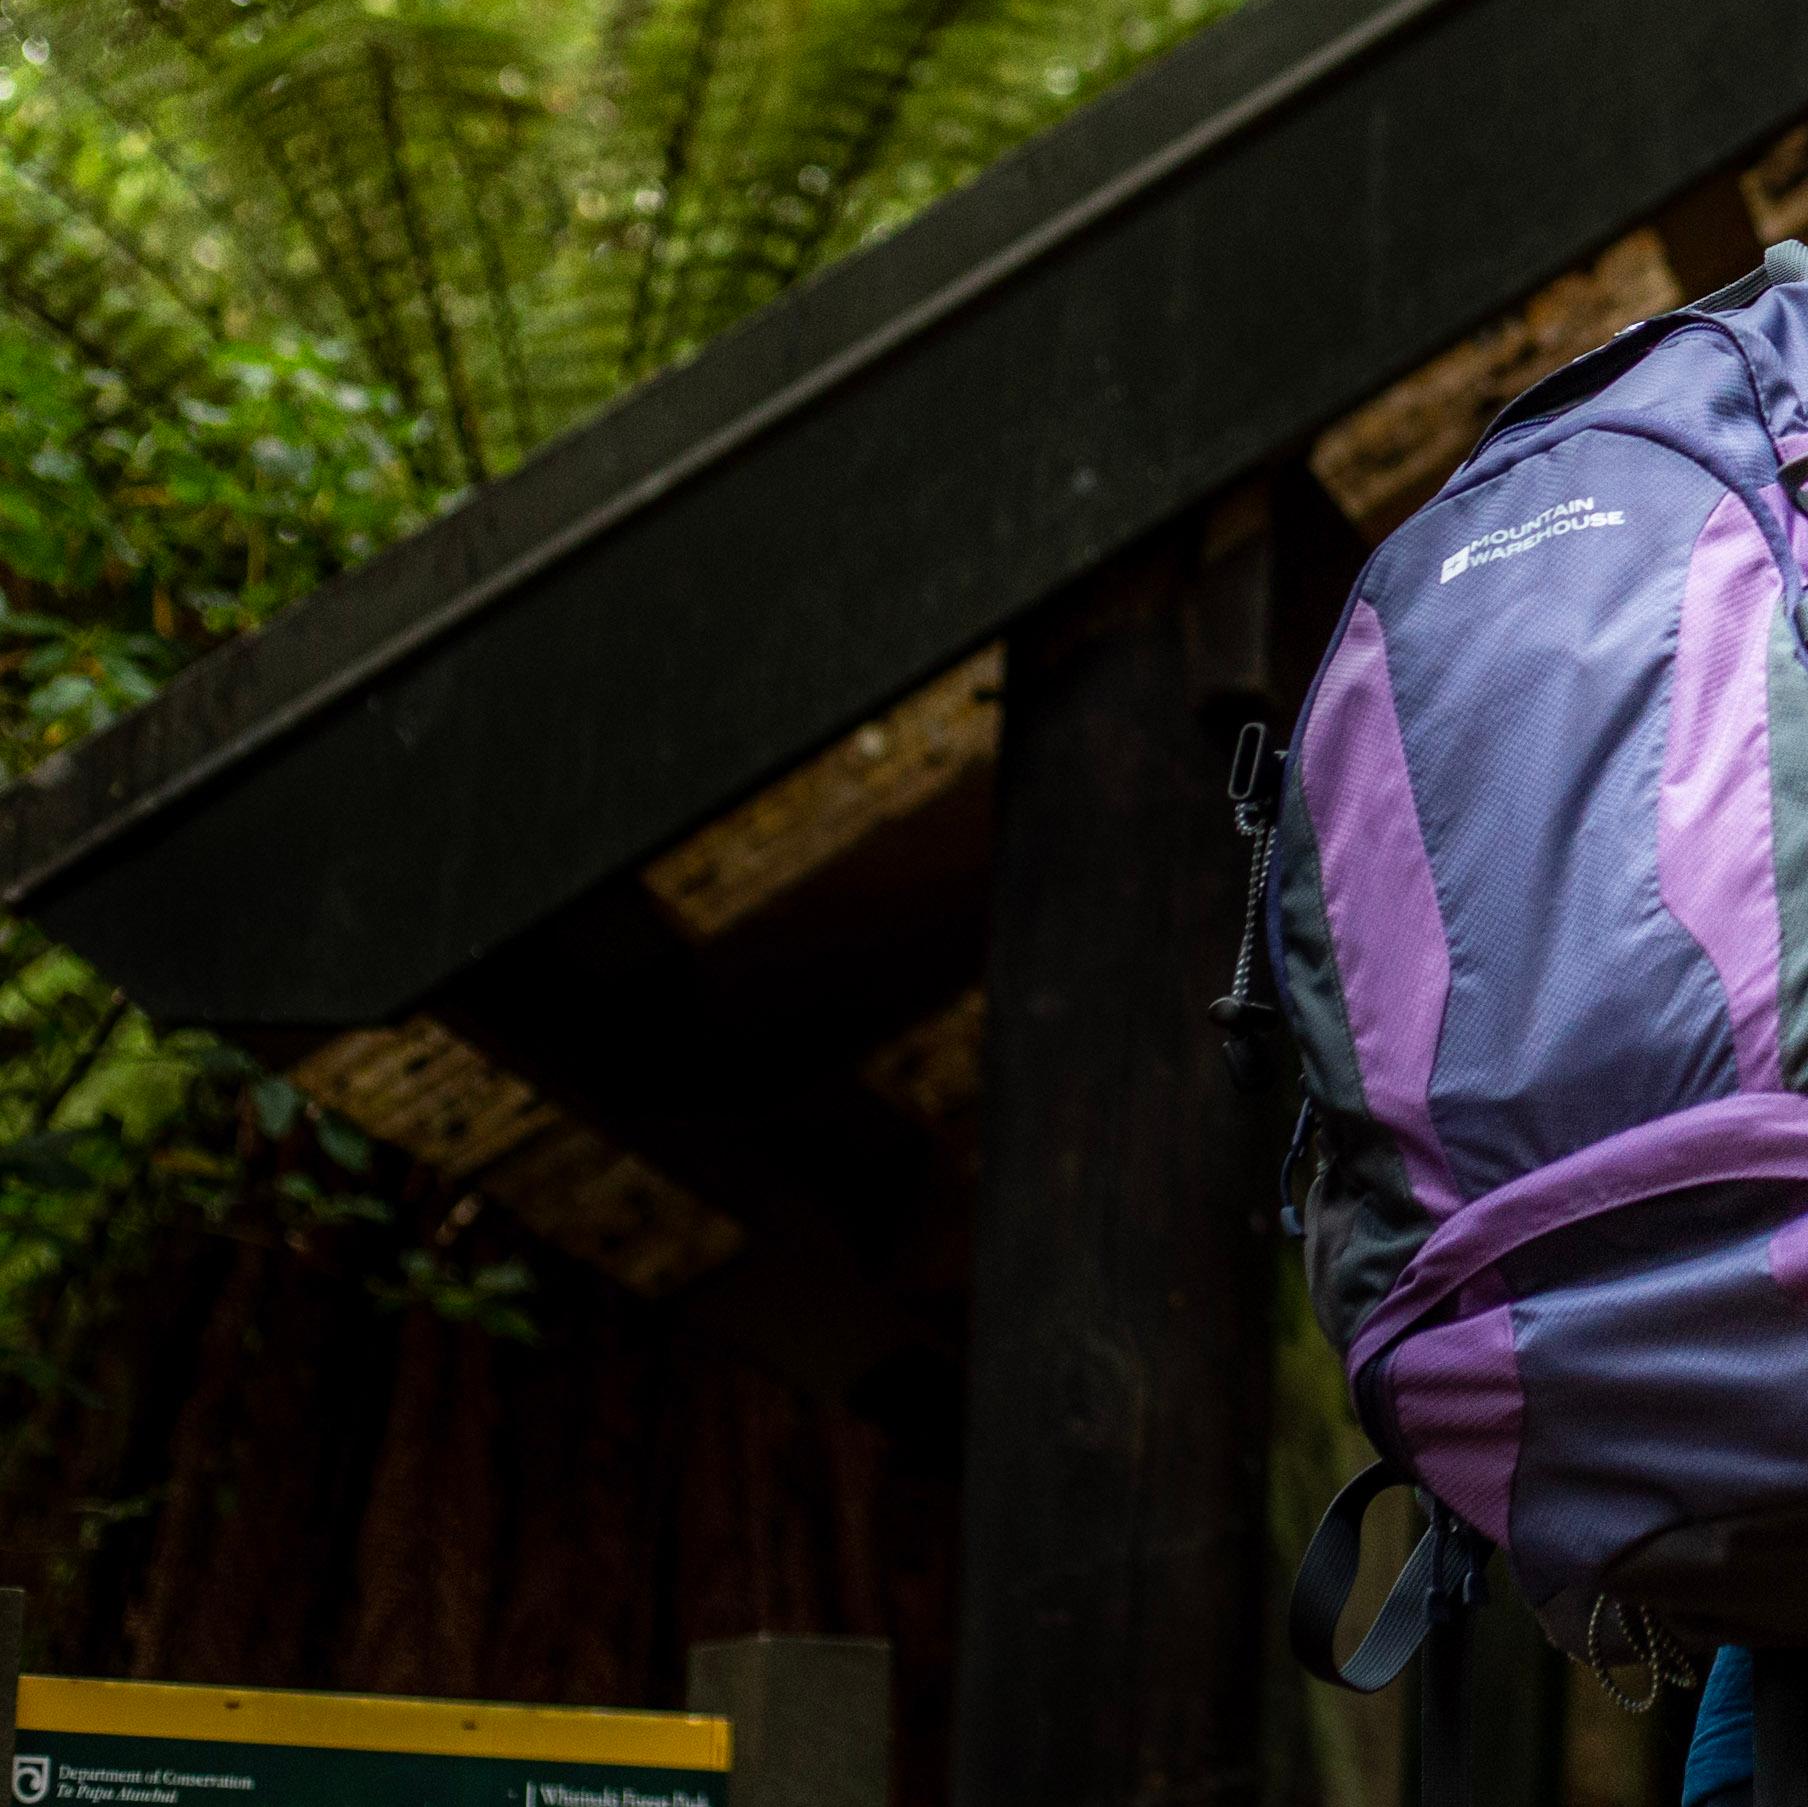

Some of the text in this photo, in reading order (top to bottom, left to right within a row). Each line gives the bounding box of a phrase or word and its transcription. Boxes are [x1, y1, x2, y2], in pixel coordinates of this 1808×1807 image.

[1469, 511, 1626, 568] WAREHOUSE
[1470, 497, 1595, 552] MOUNTAIN
[58, 1764, 255, 1790] Department of Conservation
